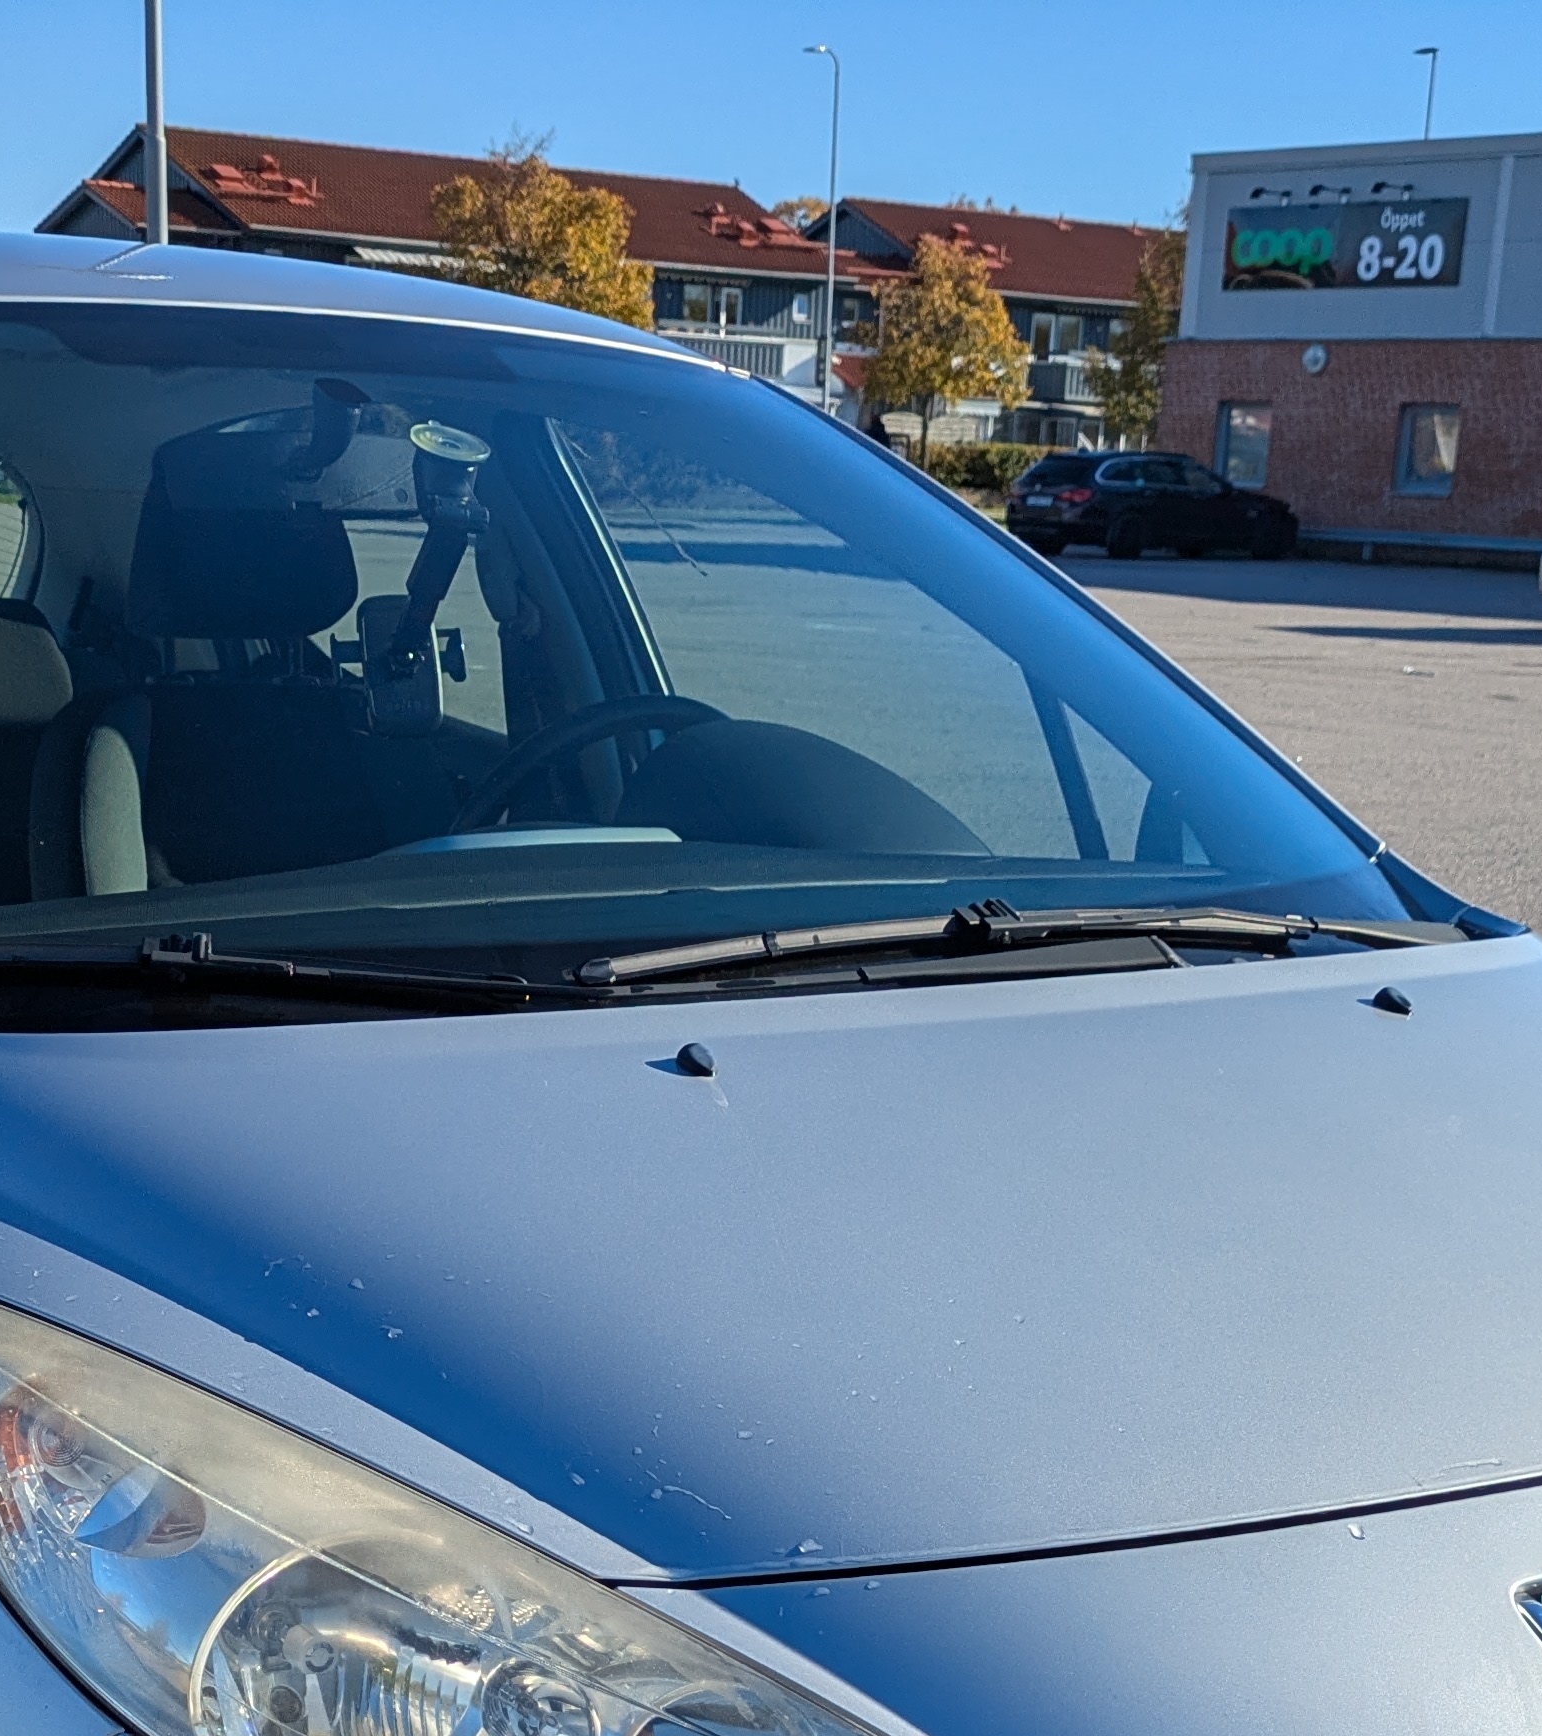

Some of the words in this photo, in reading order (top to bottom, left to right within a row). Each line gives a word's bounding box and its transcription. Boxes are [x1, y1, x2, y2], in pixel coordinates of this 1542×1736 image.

[1380, 206, 1426, 233] Öppet
[1231, 227, 1333, 275] coop
[1357, 234, 1445, 281] 8-20
